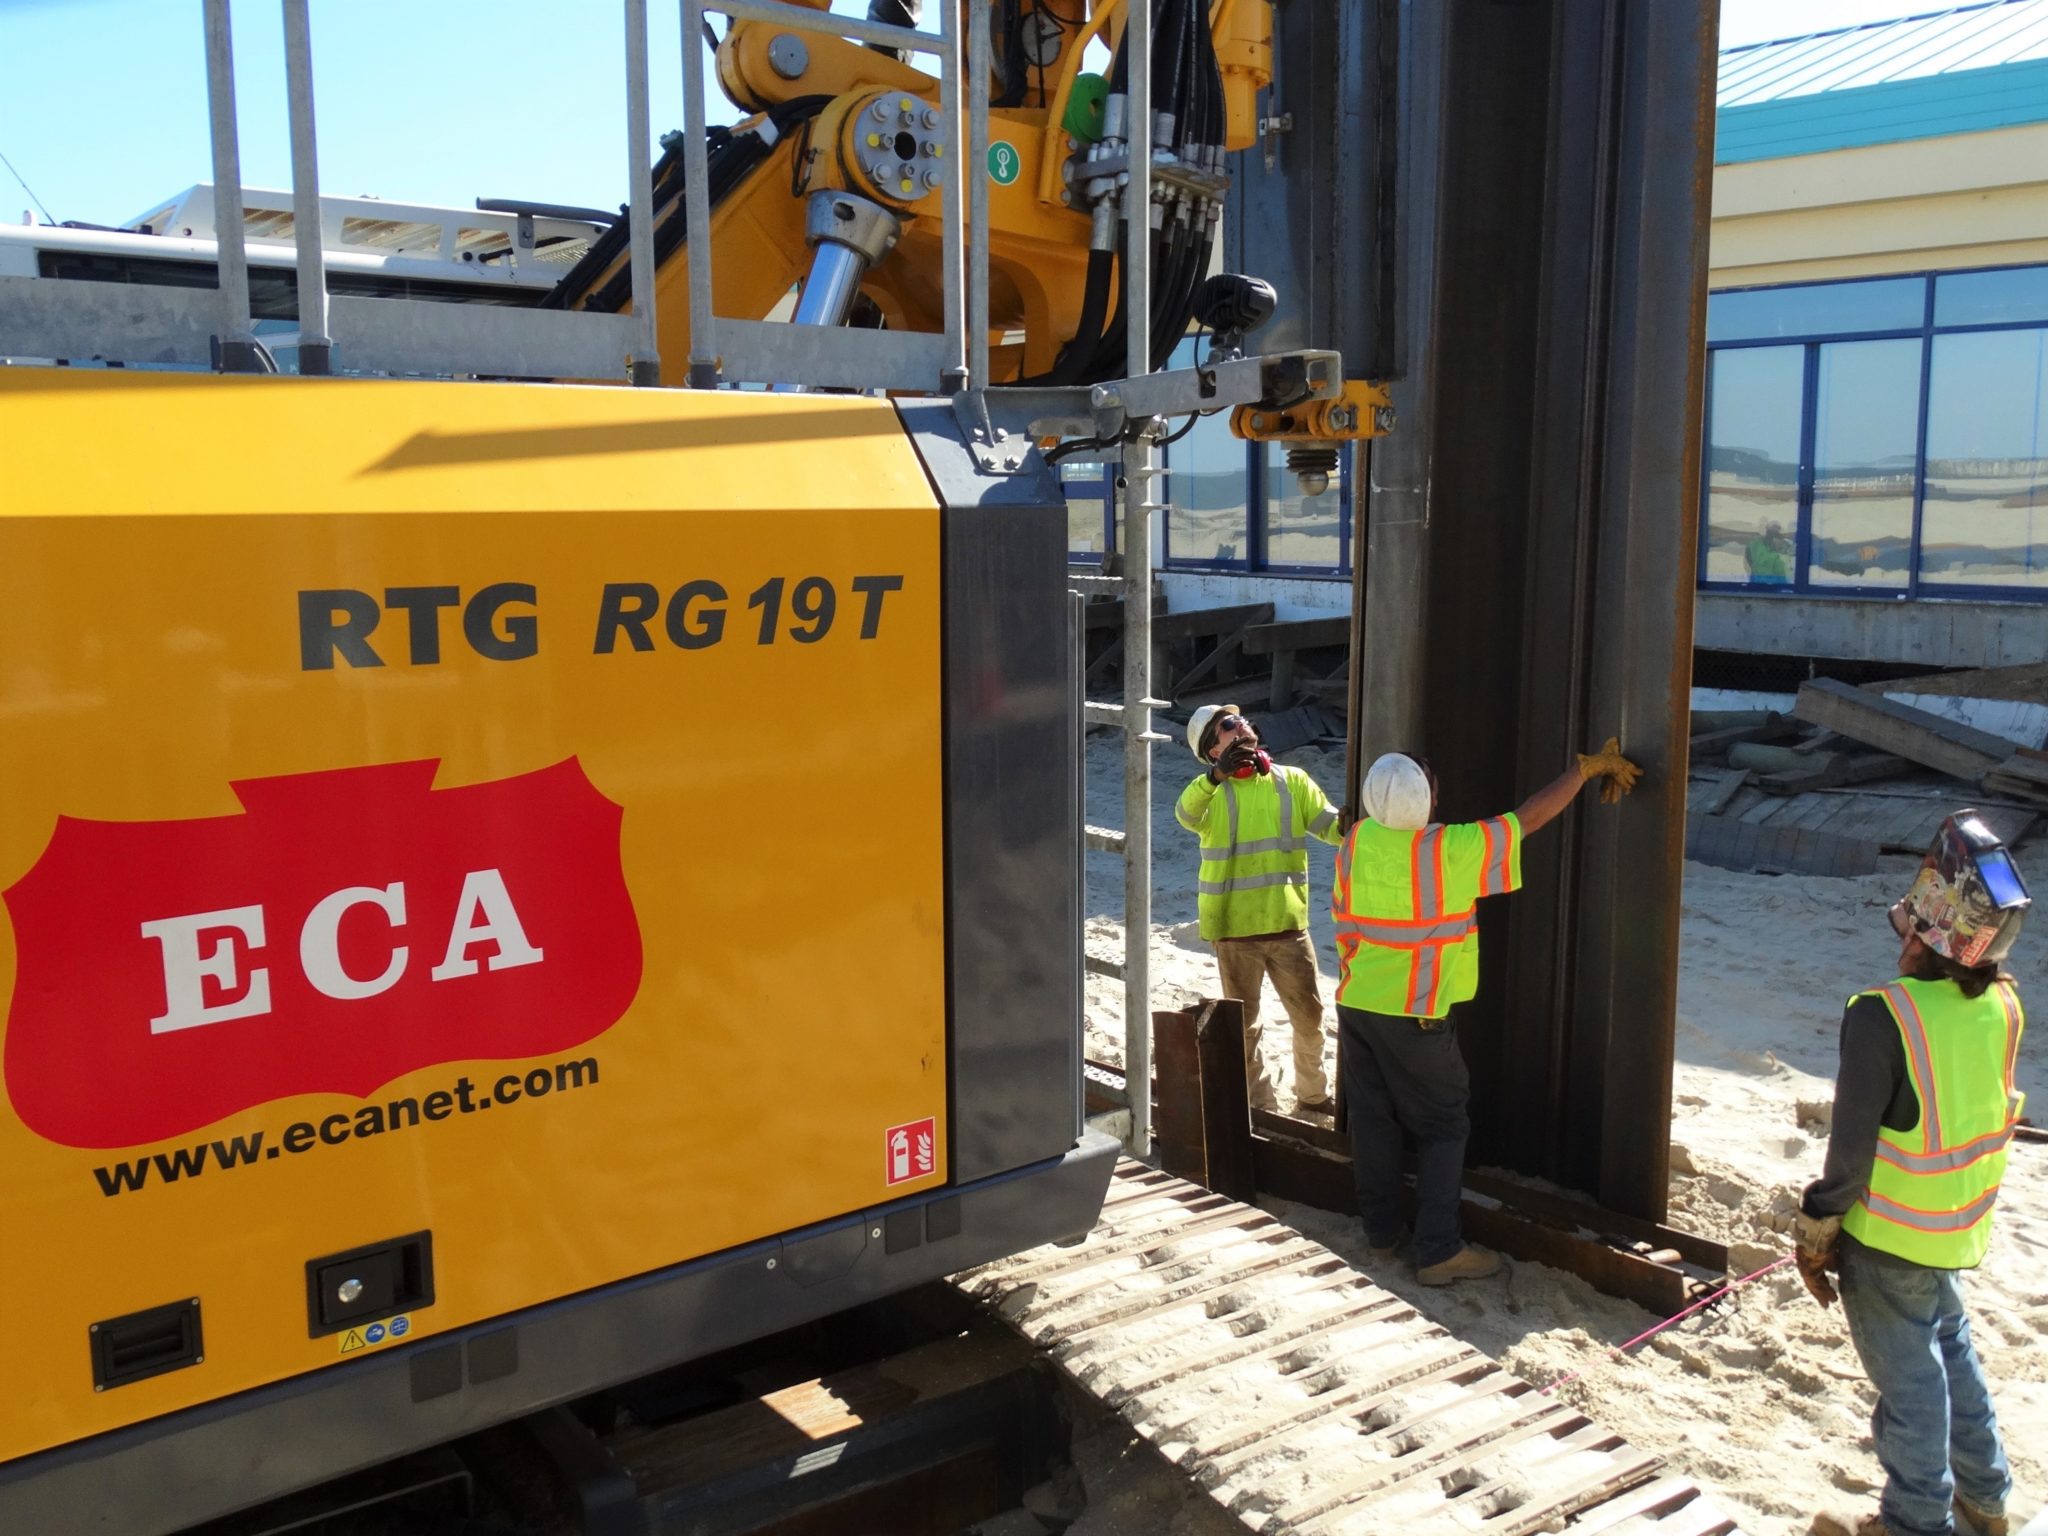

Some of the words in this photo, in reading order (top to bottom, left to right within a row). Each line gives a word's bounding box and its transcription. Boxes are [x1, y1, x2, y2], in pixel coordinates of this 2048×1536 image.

[298, 582, 539, 672] RTG
[592, 578, 729, 655] RG
[747, 575, 837, 646] 19
[851, 575, 904, 640] T
[141, 868, 544, 1035] ECA
[93, 1057, 600, 1198] www.ecanet.com
